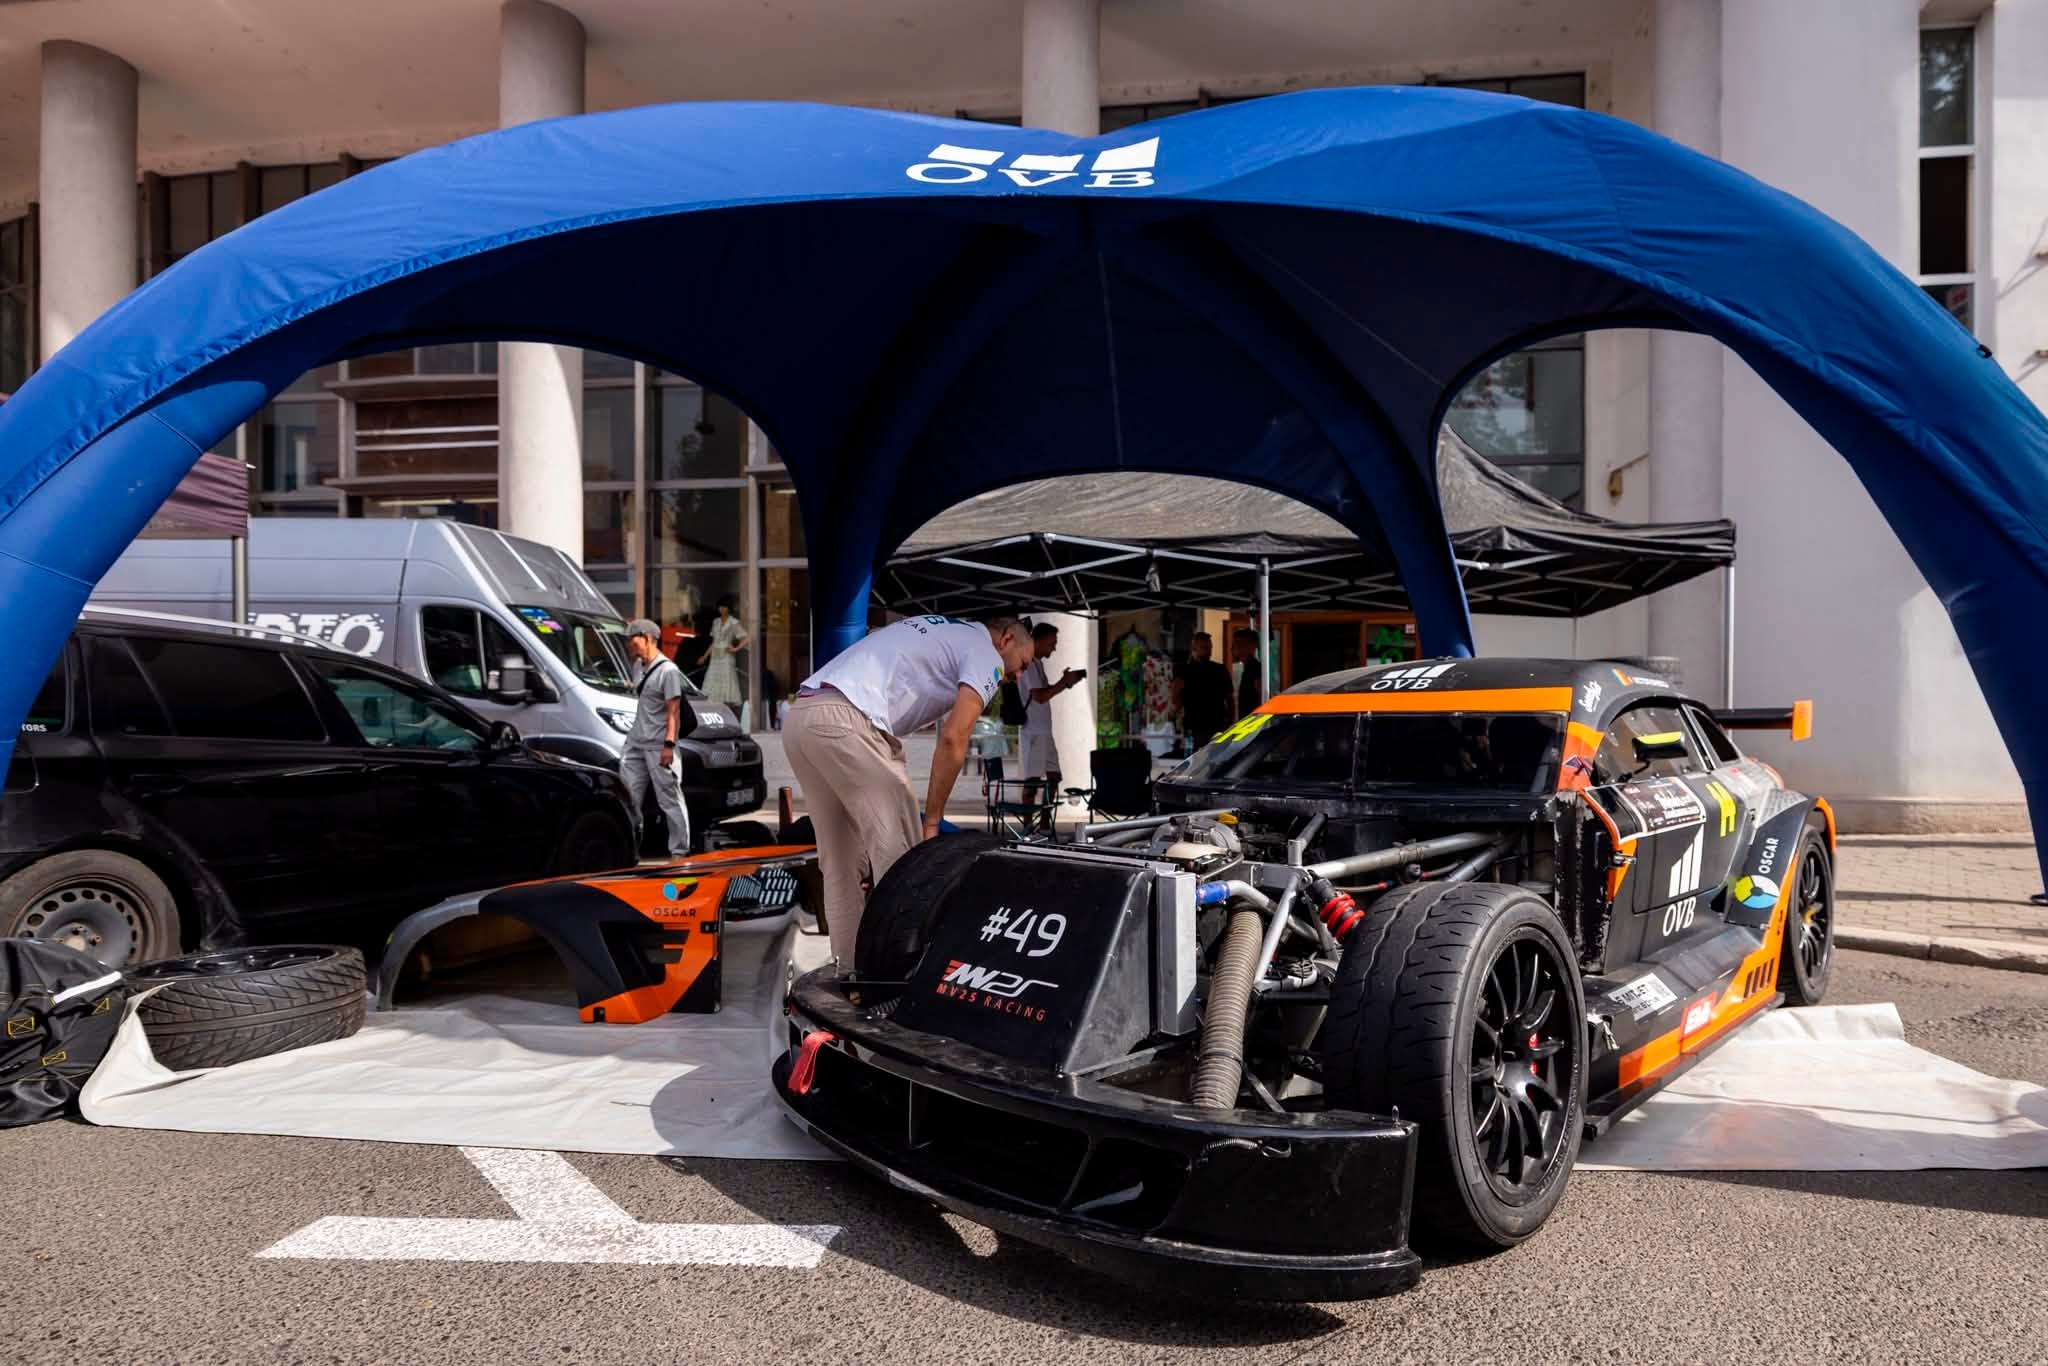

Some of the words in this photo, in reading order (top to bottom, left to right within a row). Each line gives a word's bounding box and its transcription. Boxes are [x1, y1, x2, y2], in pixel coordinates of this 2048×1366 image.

[905, 162, 1155, 188] OVB
[1370, 678, 1432, 691] OVB
[1757, 837, 1780, 875] OSCAR
[652, 906, 697, 918] OSCAR
[1661, 896, 1697, 937] OVB
[979, 906, 1067, 957] #49
[983, 996, 1046, 1022] RACING
